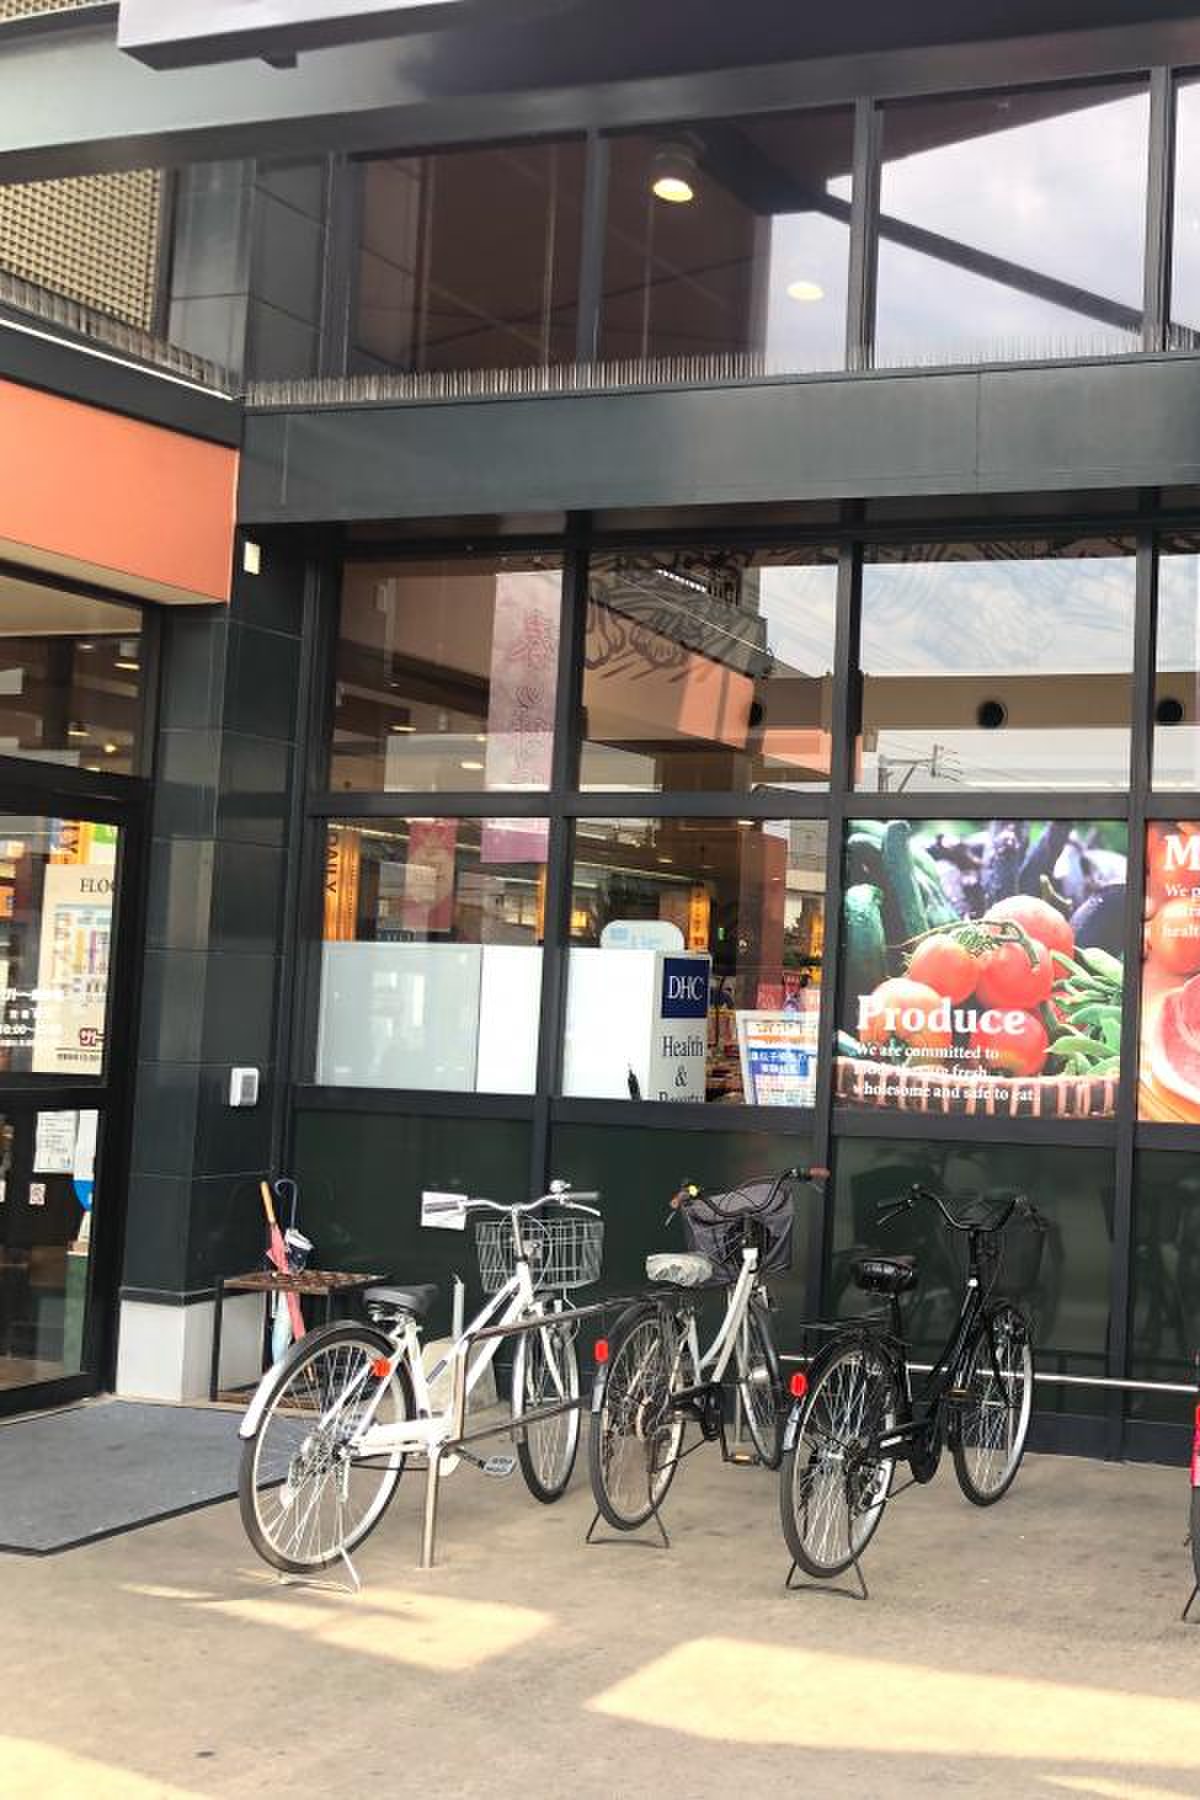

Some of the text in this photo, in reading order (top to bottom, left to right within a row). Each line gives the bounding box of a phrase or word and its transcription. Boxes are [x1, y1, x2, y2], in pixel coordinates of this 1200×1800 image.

[669, 976, 704, 1000] DHC
[857, 995, 1026, 1035] Produce
[663, 1036, 704, 1057] Health
[985, 1047, 1000, 1059] to
[675, 1065, 688, 1087] &
